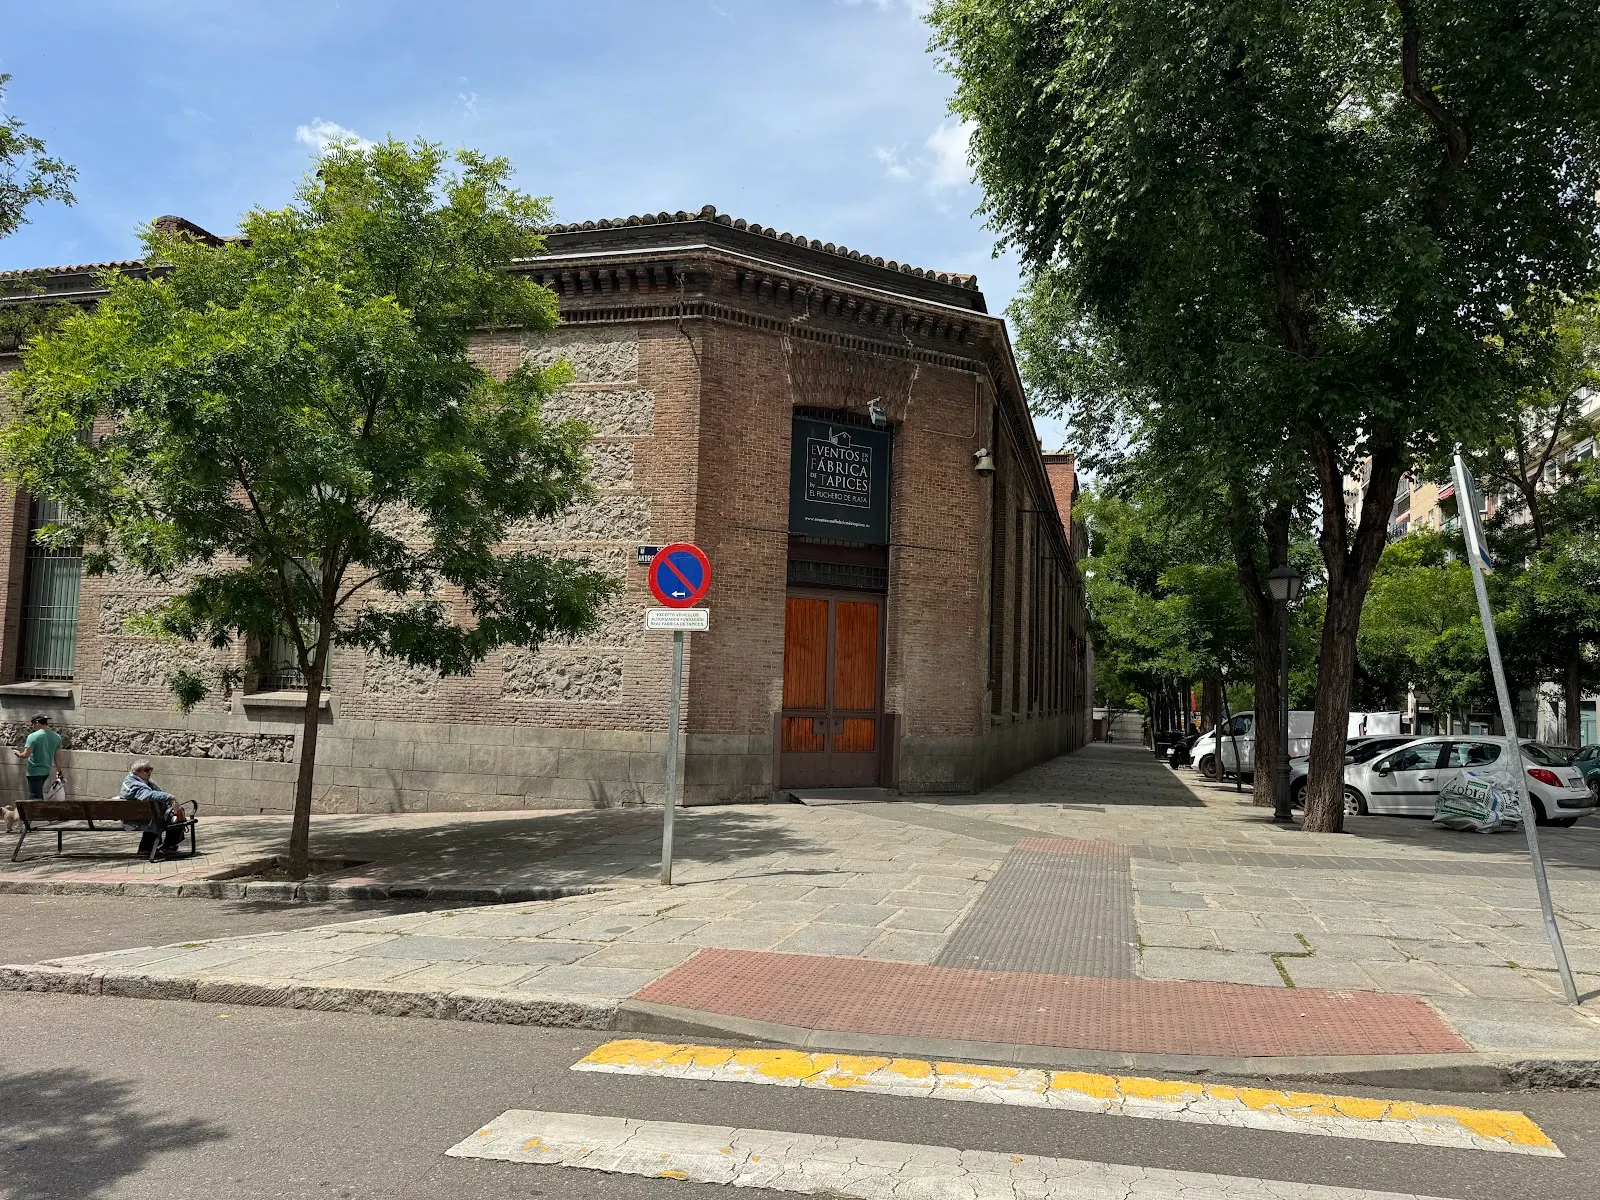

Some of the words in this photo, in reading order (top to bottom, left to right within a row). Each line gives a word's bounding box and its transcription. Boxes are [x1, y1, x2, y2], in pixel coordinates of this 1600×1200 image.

[812, 445, 860, 461] EVENTOS
[811, 457, 868, 477] FÁBRICA
[819, 474, 868, 491] TAPICES
[817, 491, 842, 500] PUCHERO
